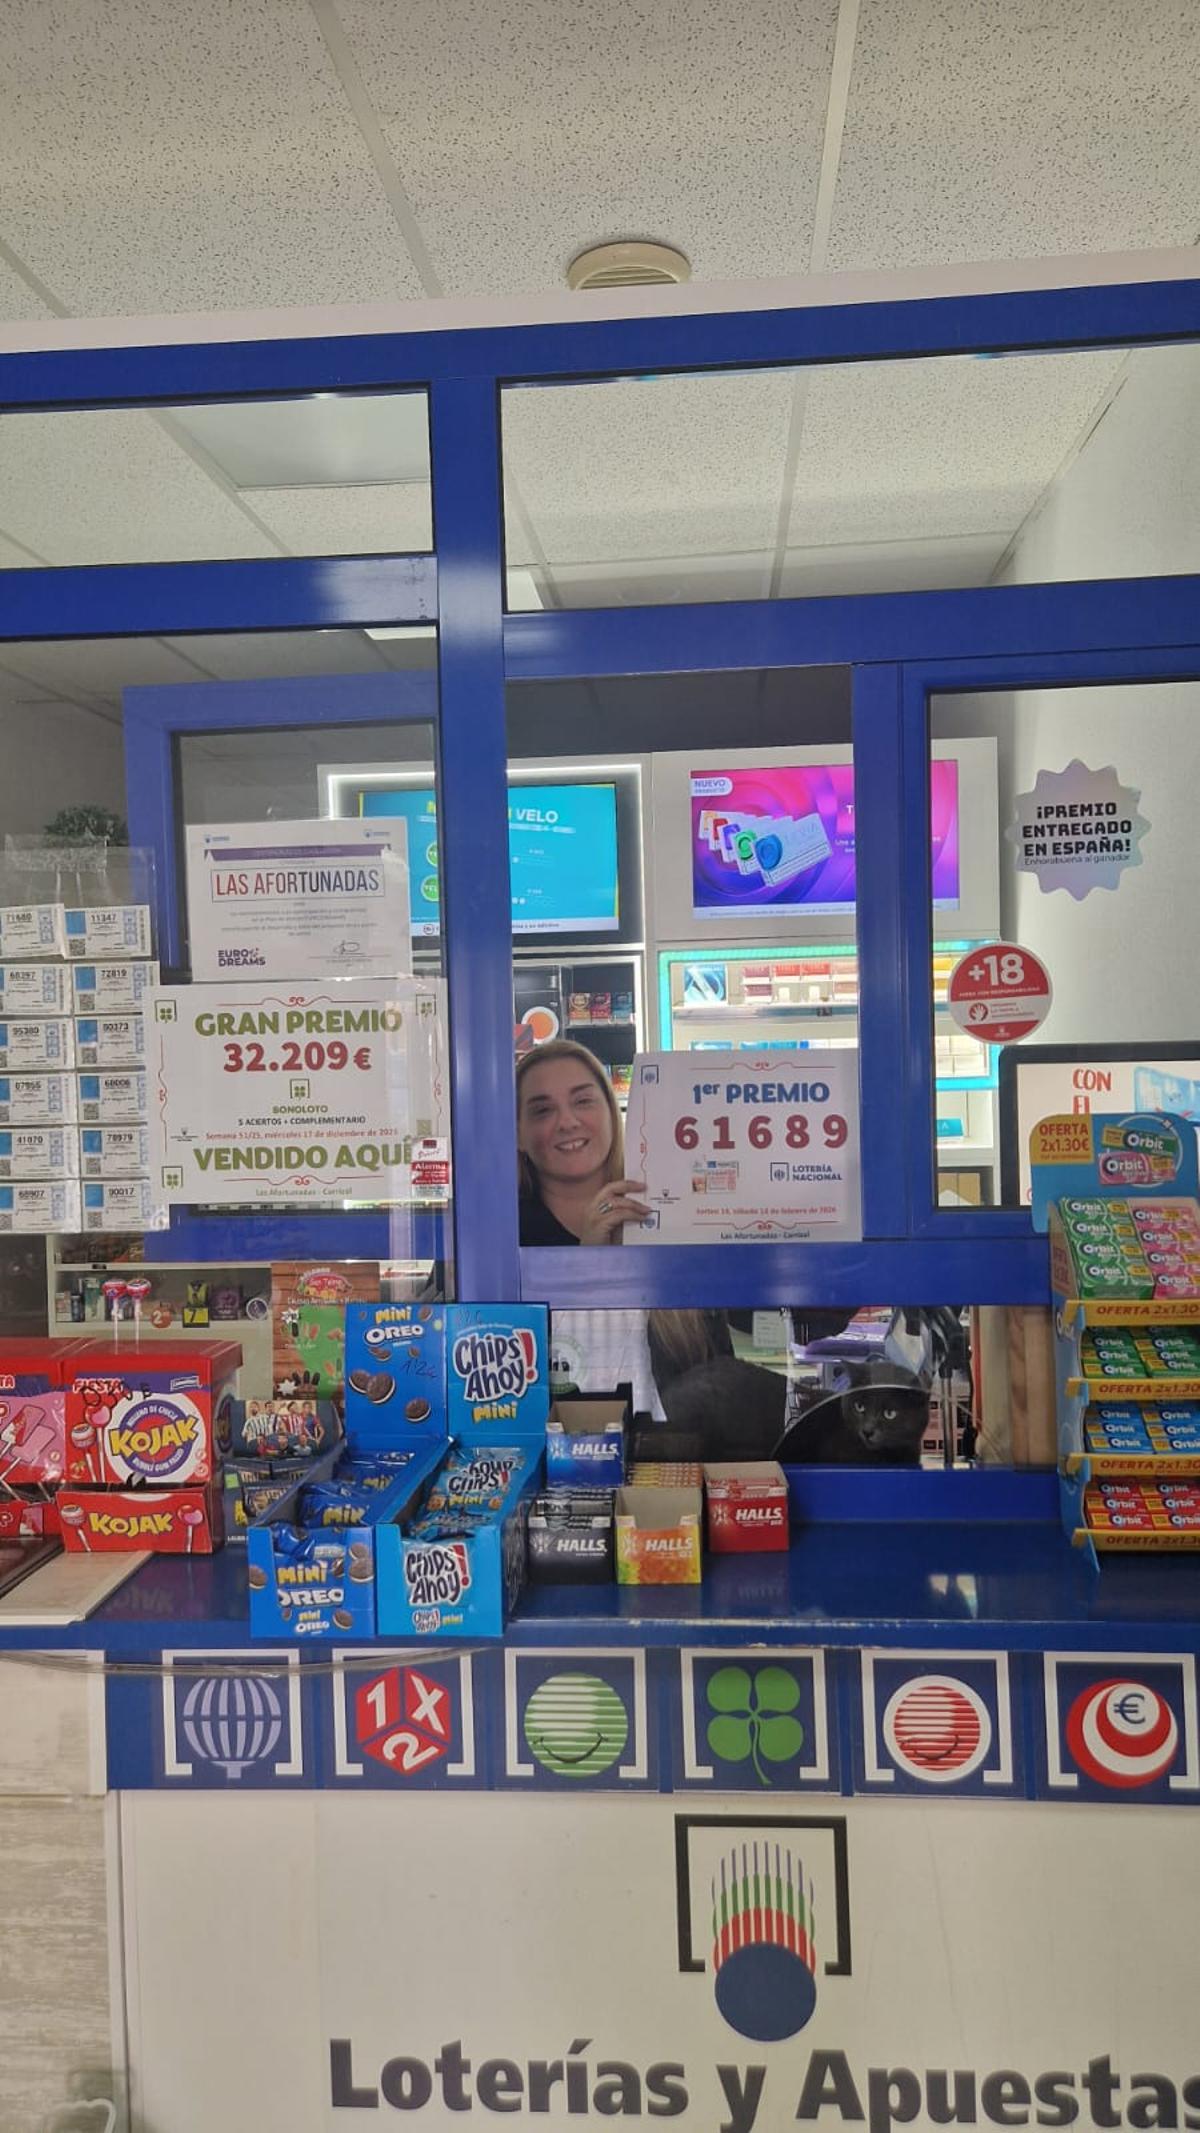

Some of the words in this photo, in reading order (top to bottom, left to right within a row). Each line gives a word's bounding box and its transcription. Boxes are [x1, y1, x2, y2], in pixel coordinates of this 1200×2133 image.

[695, 779, 725, 788] NUEVO
[516, 808, 558, 823] VELO
[1037, 802, 1117, 819] ¡PREMIO
[1022, 820, 1132, 838] ENTREGADO
[1024, 843, 1047, 857] EN
[1052, 836, 1131, 855] ESPAÑA!
[1024, 856, 1083, 866] Enhorabuena
[1094, 854, 1130, 865] ganador
[215, 873, 248, 896] LAS
[254, 869, 379, 895] AFORTUNADAS
[218, 950, 248, 958] EURO
[218, 957, 266, 967] DREAMS
[968, 953, 1024, 986] +18
[195, 1011, 279, 1036] GRAN
[286, 1009, 403, 1034] PREMIO
[1073, 1069, 1111, 1091] CON
[693, 1083, 720, 1104] 1er
[726, 1082, 830, 1104] PREMIO
[272, 1105, 329, 1114] BONOLOTO
[245, 1117, 282, 1126] ACIERTOS
[290, 1116, 366, 1125] COMPLEMENTARIO
[1039, 1123, 1089, 1136] OFERTA
[1040, 1138, 1089, 1153] 2x1.30€
[1127, 1133, 1163, 1150] Orbit
[193, 1146, 329, 1171] VENDIDO
[792, 1164, 833, 1173] LOTERÍA
[1106, 1160, 1143, 1173] Orbit
[792, 1172, 842, 1181] NACIONAL
[1071, 1203, 1101, 1212] Orbit
[1076, 1223, 1107, 1233] Orbit
[1083, 1244, 1114, 1254] Orbit
[1089, 1266, 1121, 1276] Orbit
[1096, 1305, 1149, 1315] OFERTA
[366, 1324, 424, 1345] OREO
[1155, 1338, 1184, 1348] Orbit
[455, 1334, 521, 1377] Chips
[1099, 1350, 1129, 1359] Orbit
[1160, 1351, 1190, 1360] Orbit
[1103, 1365, 1134, 1374] Orbit
[73, 1378, 124, 1394] FIESTA
[1099, 1384, 1152, 1393] OFERTA
[1162, 1411, 1191, 1420] Orbit
[1105, 1424, 1135, 1433] Orbit
[1166, 1426, 1197, 1434] Orbit
[109, 1416, 199, 1458] KOJAK
[1110, 1438, 1141, 1447] Orbit
[572, 1443, 618, 1455] HALLS
[1100, 1459, 1153, 1469] OFERTA
[1101, 1484, 1130, 1493] Orbit
[1106, 1499, 1137, 1509] Orbit
[1165, 1499, 1196, 1508] Orbit
[736, 1507, 782, 1521] HALLS
[88, 1511, 174, 1538] KOJAK
[1112, 1515, 1142, 1525] Orbit
[557, 1539, 606, 1552] HALLS
[645, 1537, 693, 1551] HALLS
[1106, 1536, 1159, 1545] OFERTA
[406, 1549, 456, 1584] Chips
[277, 1588, 344, 1607] OREO
[331, 2038, 690, 2116] Loterías
[714, 2062, 768, 2131] y
